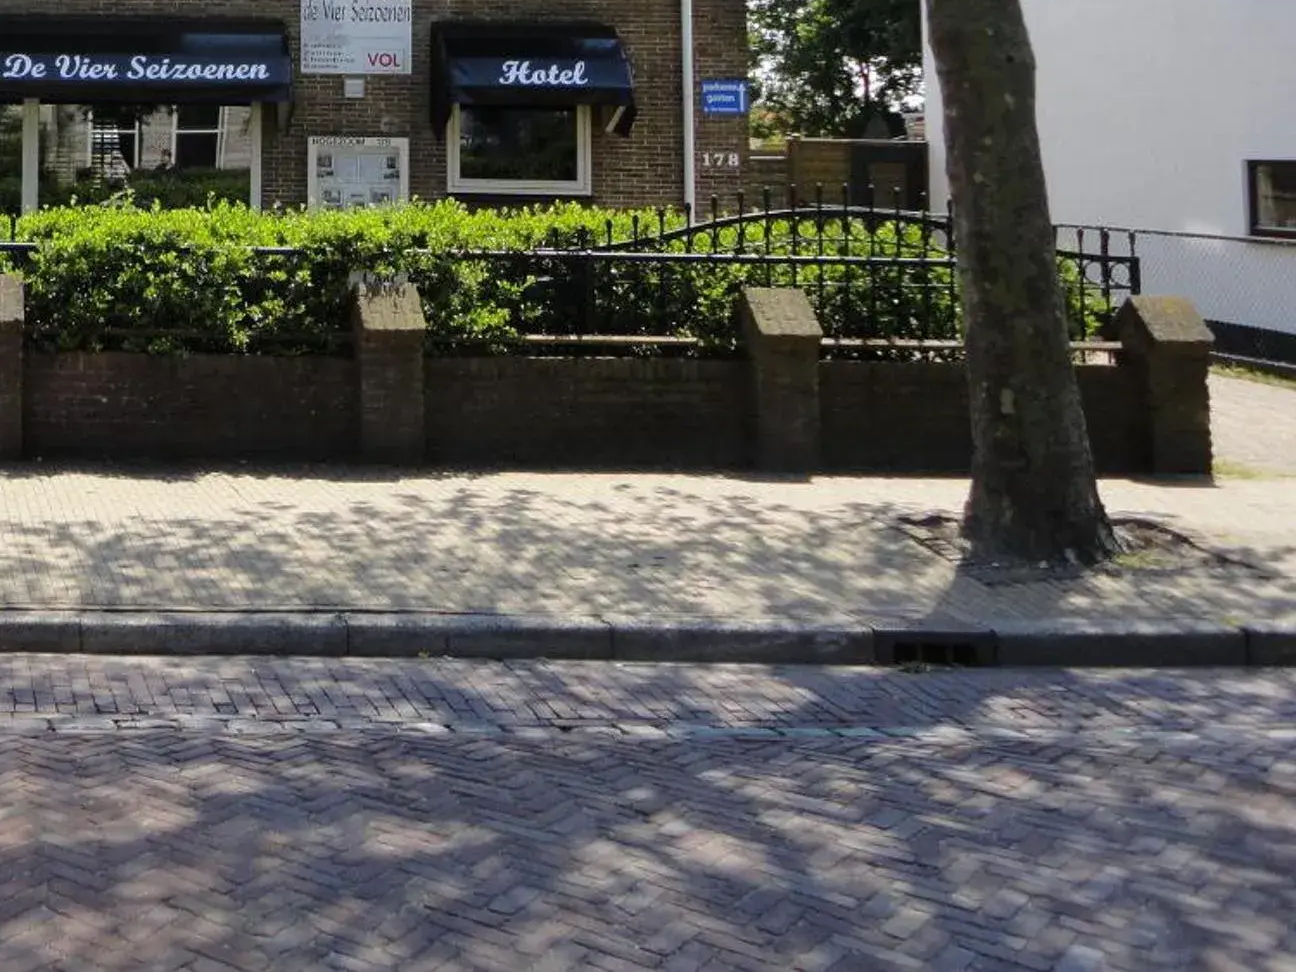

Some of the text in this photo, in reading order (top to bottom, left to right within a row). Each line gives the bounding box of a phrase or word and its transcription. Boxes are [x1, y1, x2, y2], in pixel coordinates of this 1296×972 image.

[4, 54, 46, 78] De
[55, 55, 117, 80] Vier
[127, 55, 270, 80] Seizoenen
[367, 52, 401, 68] VOL
[498, 59, 589, 85] Hotel
[702, 153, 739, 167] 178
